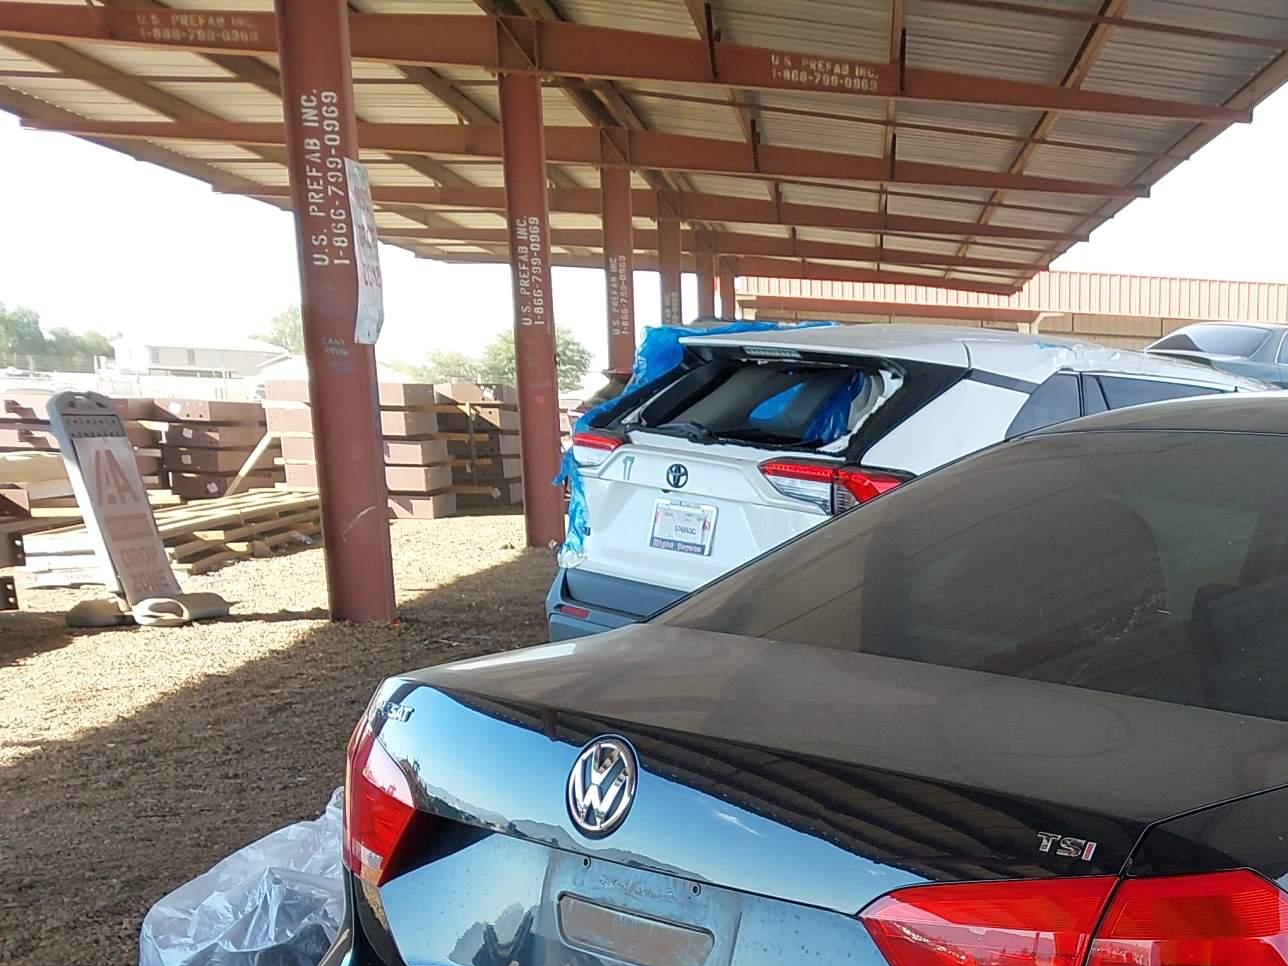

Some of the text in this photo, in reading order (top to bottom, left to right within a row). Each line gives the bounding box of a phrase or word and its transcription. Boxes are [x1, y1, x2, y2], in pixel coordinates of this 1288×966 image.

[300, 89, 329, 266] U.S. PREFAB INC.
[321, 91, 351, 265] 1-866-799-0969
[516, 216, 528, 240] INC.
[518, 246, 531, 296] PREFAB
[528, 216, 545, 325] 1-866-799-0969
[1037, 831, 1097, 861] TSI
